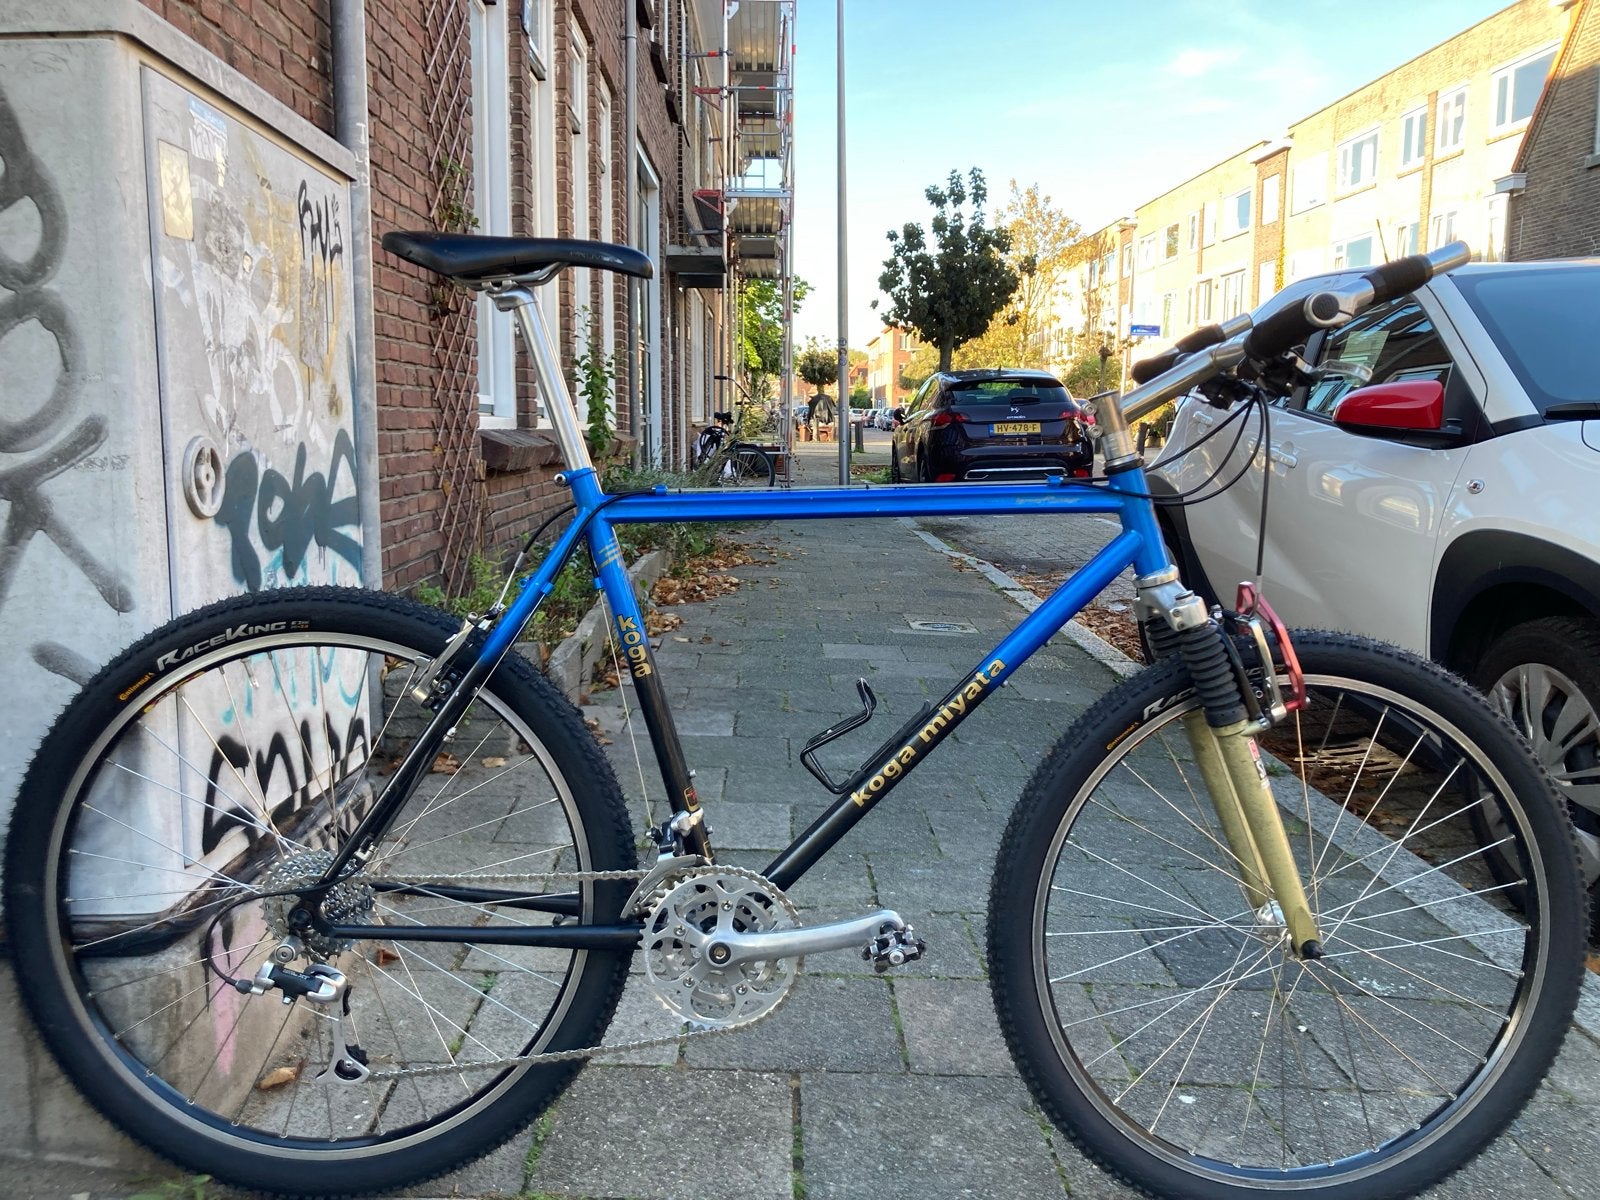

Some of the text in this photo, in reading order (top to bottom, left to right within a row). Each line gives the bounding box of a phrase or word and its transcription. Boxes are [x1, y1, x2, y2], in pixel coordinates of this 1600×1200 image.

[996, 423, 1038, 432] HV-478-F
[617, 614, 652, 678] koga
[850, 659, 1007, 808] koga miyata
